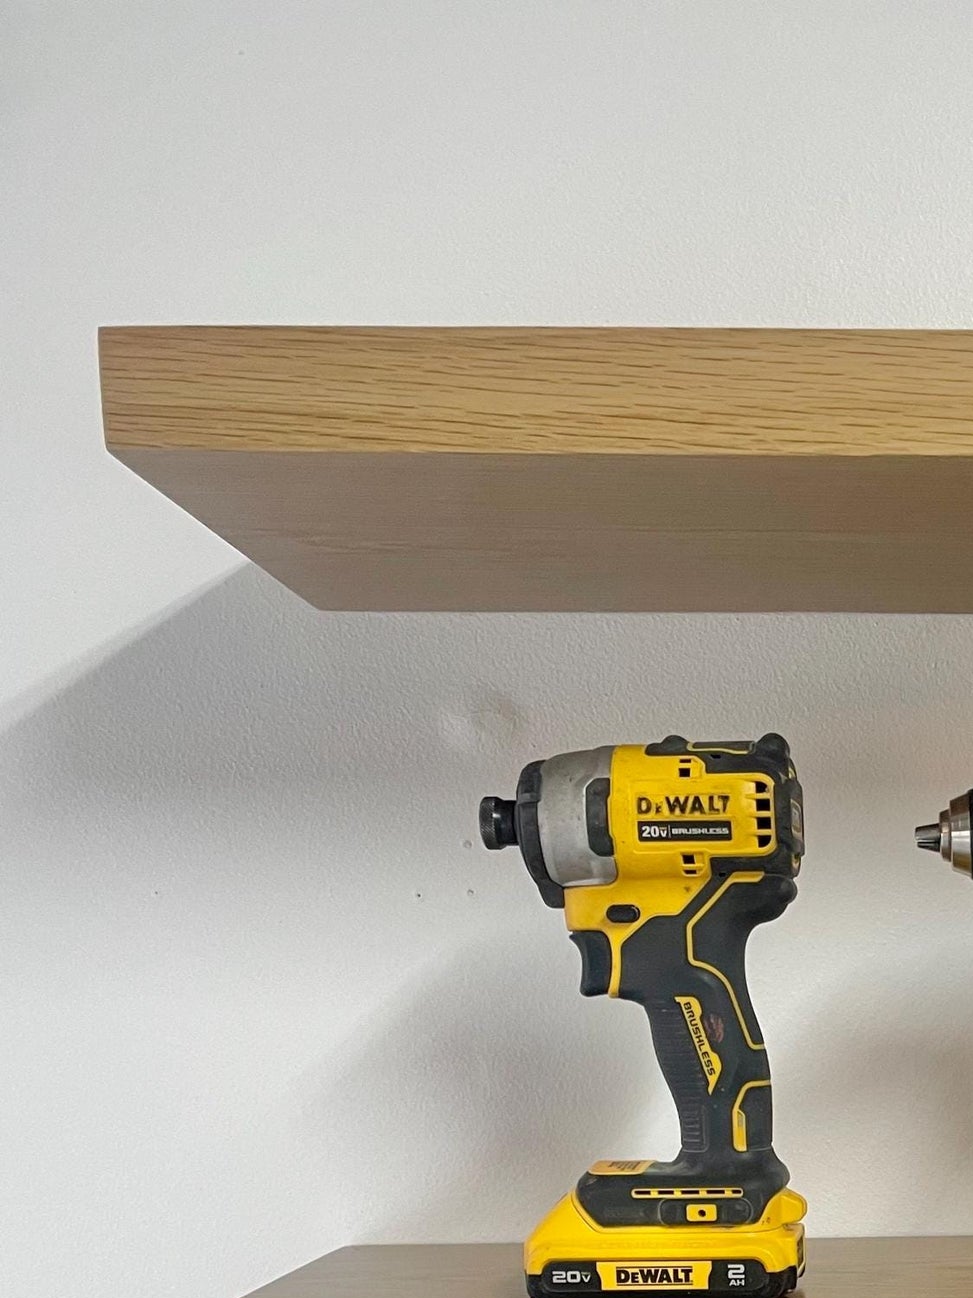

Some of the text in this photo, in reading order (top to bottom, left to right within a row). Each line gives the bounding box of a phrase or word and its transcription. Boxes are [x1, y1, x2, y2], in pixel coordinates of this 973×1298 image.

[671, 826, 729, 836] BRUSHLESS
[683, 1001, 717, 1076] BRUSHLESS
[729, 1279, 745, 1287] AH
